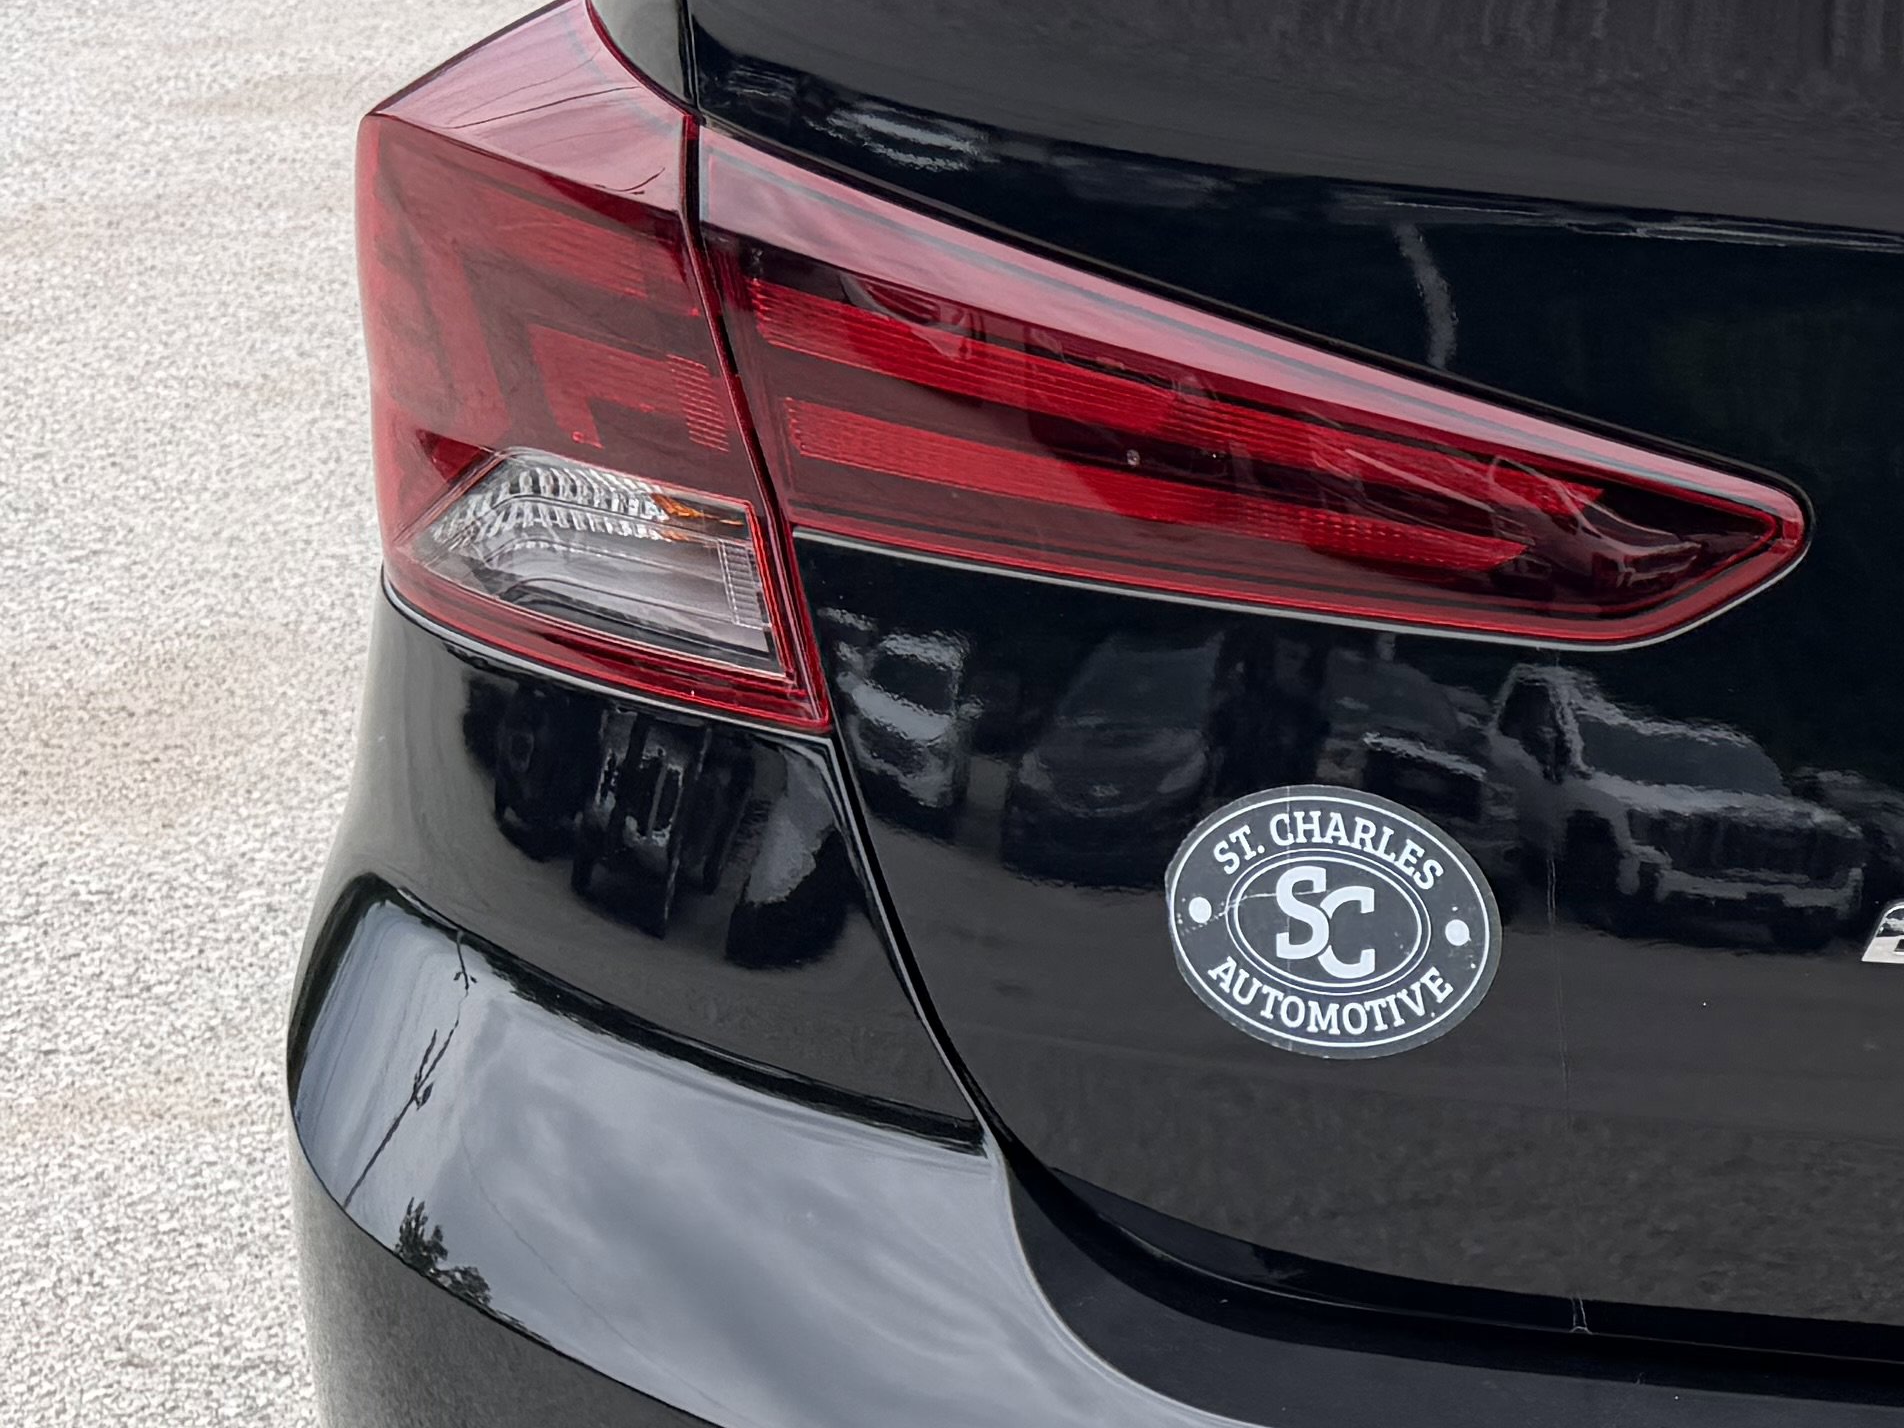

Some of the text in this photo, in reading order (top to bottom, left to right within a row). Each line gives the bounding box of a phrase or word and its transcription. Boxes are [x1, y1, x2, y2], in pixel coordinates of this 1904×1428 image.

[1213, 809, 1444, 890] ST. CHARLES
[1275, 865, 1376, 979] SC
[1207, 955, 1454, 1036] AUTOMOTIVE
